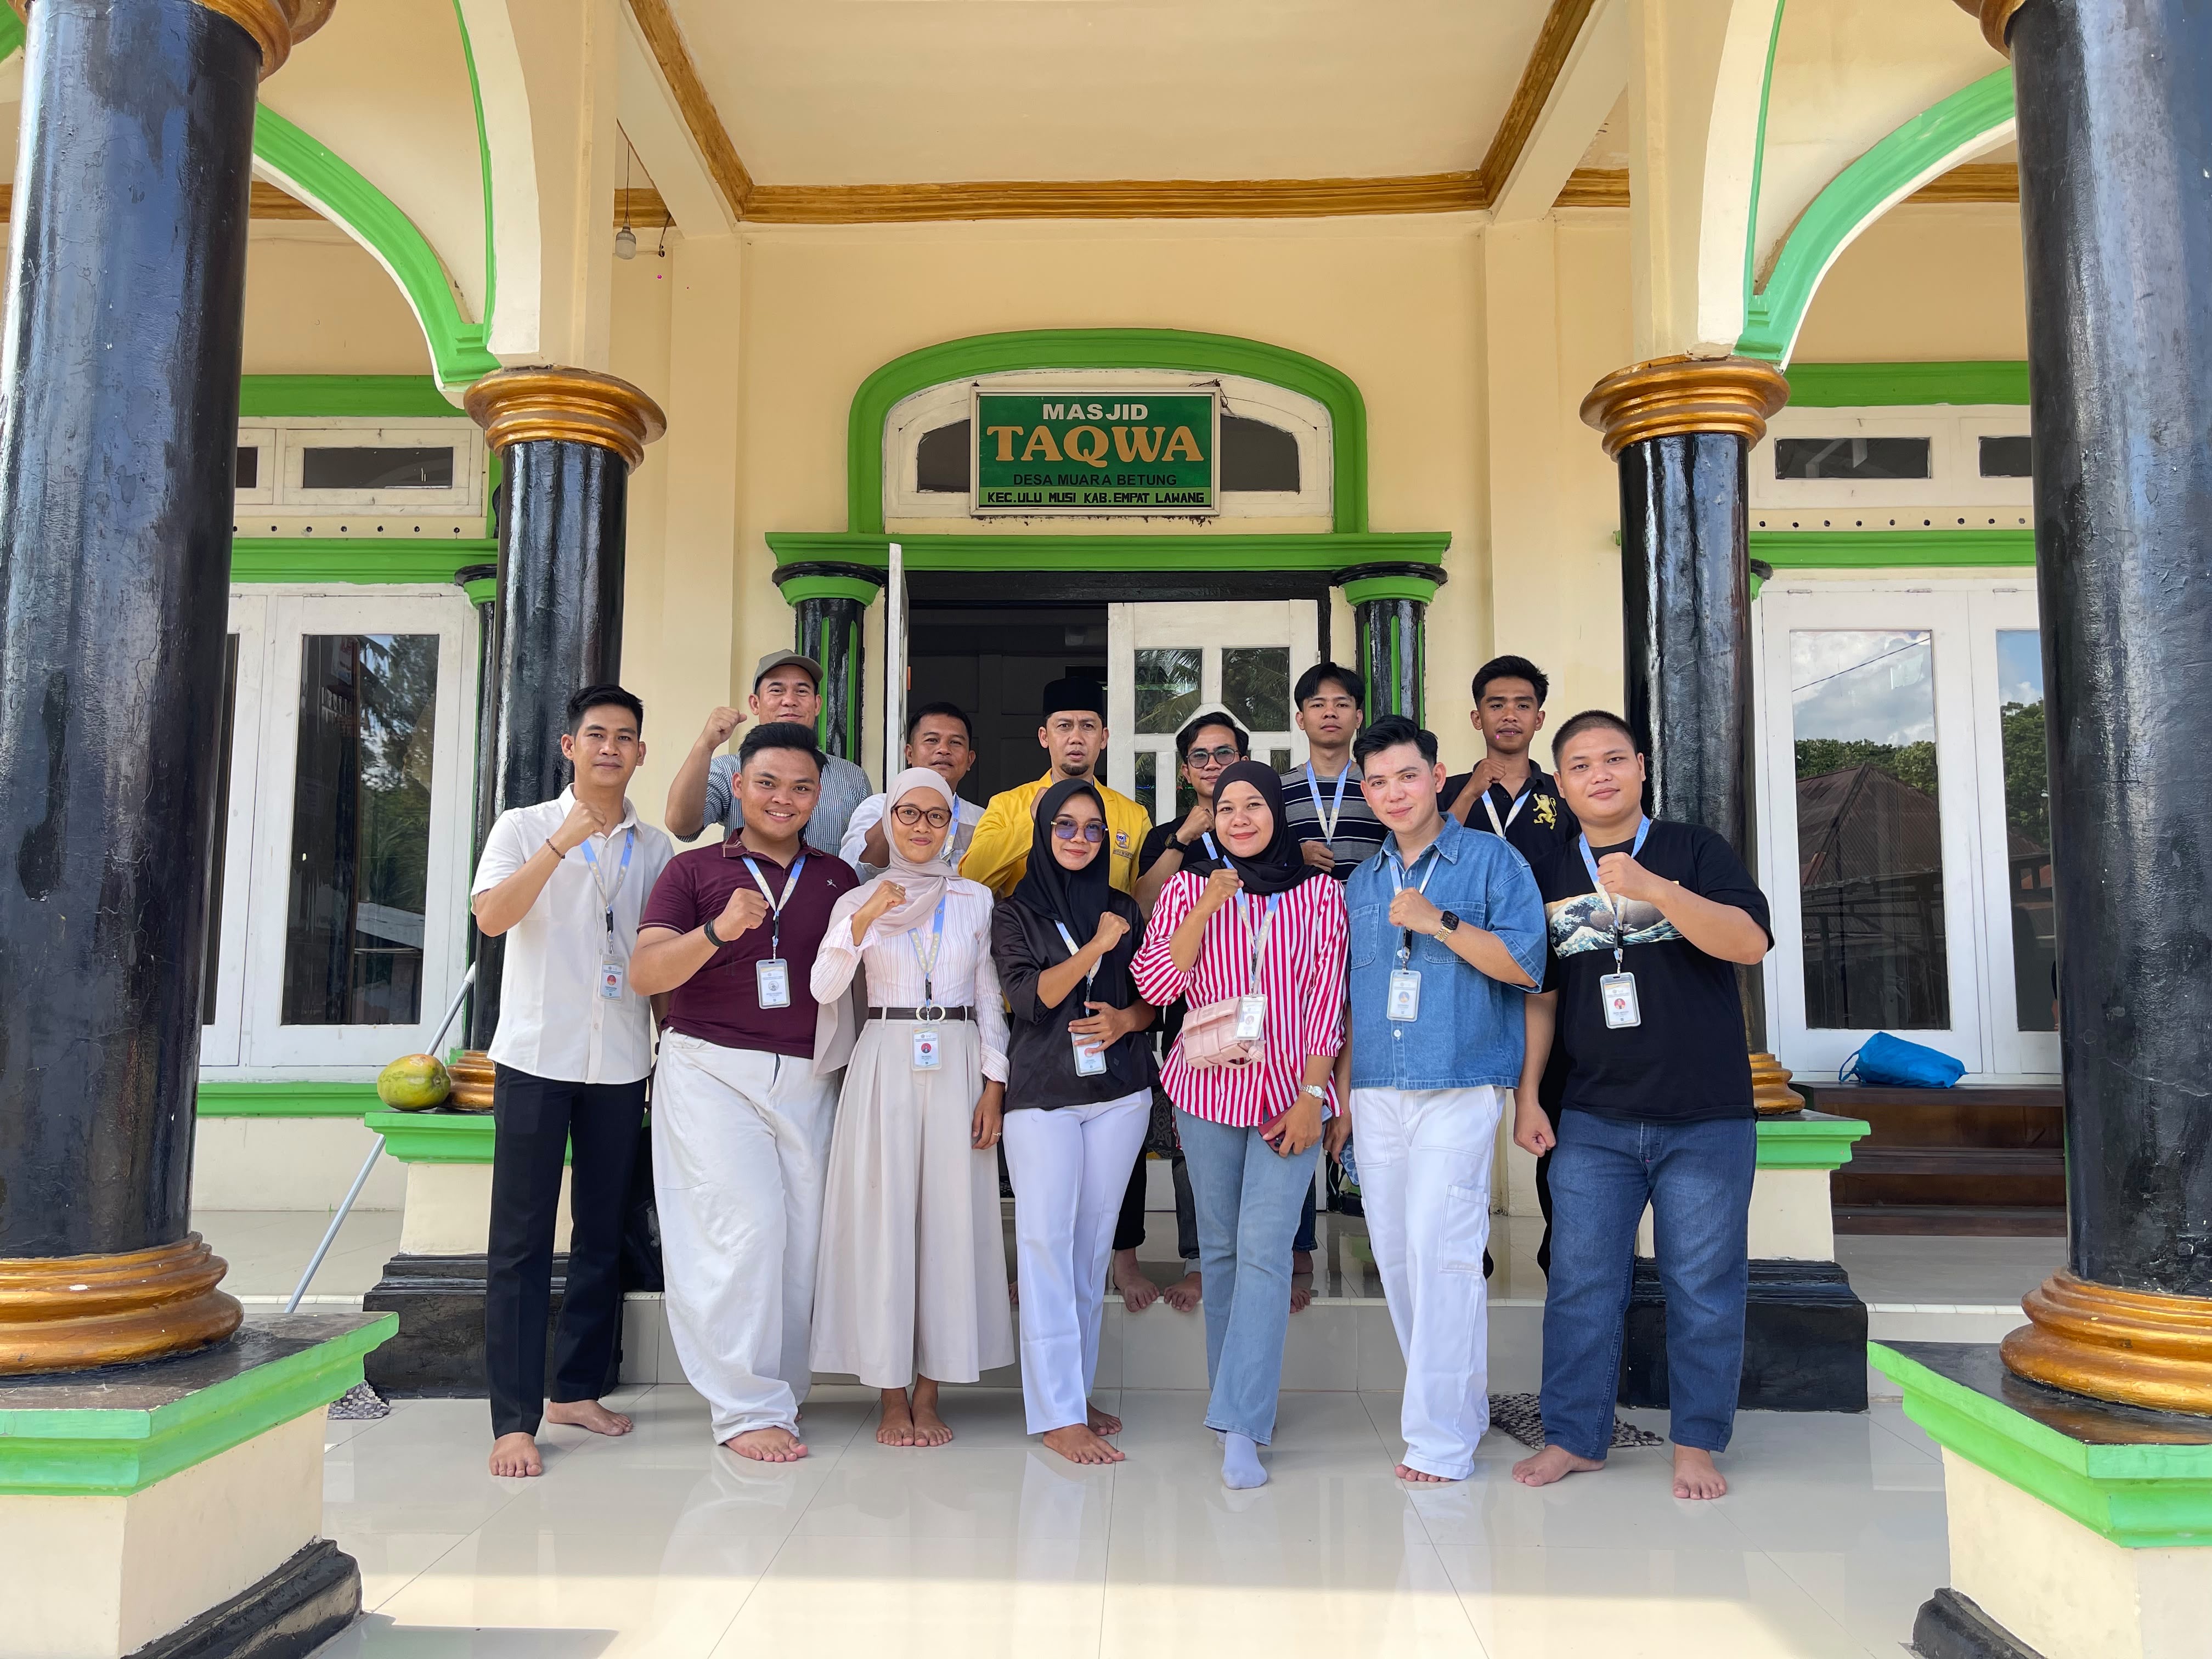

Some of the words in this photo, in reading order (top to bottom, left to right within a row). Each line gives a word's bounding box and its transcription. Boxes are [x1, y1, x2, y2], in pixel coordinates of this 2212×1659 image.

[1043, 404, 1148, 420] MASJID
[986, 425, 1204, 468] TAQWA
[1013, 474, 1053, 486] DESA
[1058, 474, 1112, 486] MUARA
[1117, 474, 1177, 486] BETUNG
[1048, 492, 1076, 503] MUSI
[1155, 492, 1204, 503] LAWANG
